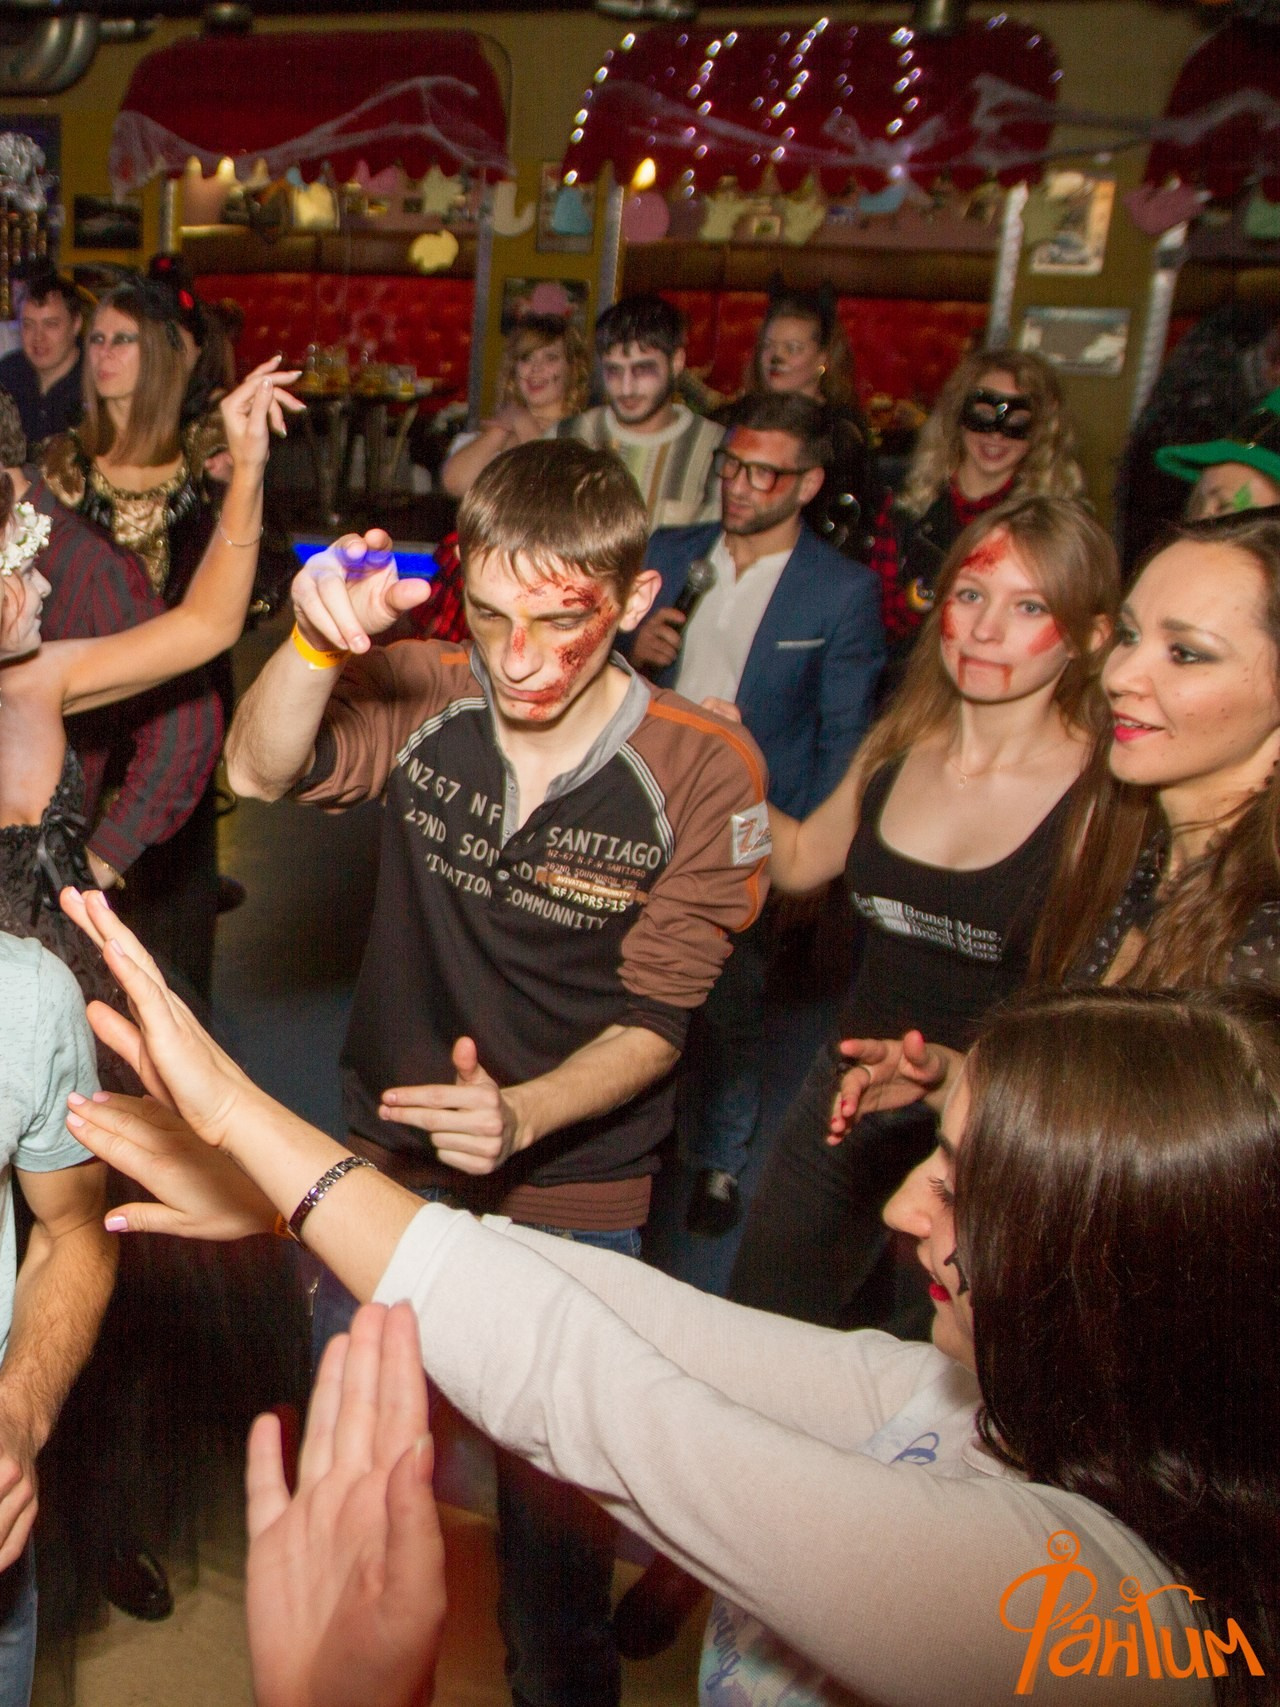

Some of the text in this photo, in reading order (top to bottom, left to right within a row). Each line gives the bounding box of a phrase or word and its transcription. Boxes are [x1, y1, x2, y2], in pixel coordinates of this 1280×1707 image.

[546, 826, 662, 870] SANTIAGO
[607, 863, 646, 879] SANTIAGO
[506, 885, 609, 930] OMMUNNITY
[904, 903, 954, 930] Brunch
[957, 920, 1003, 942] More,
